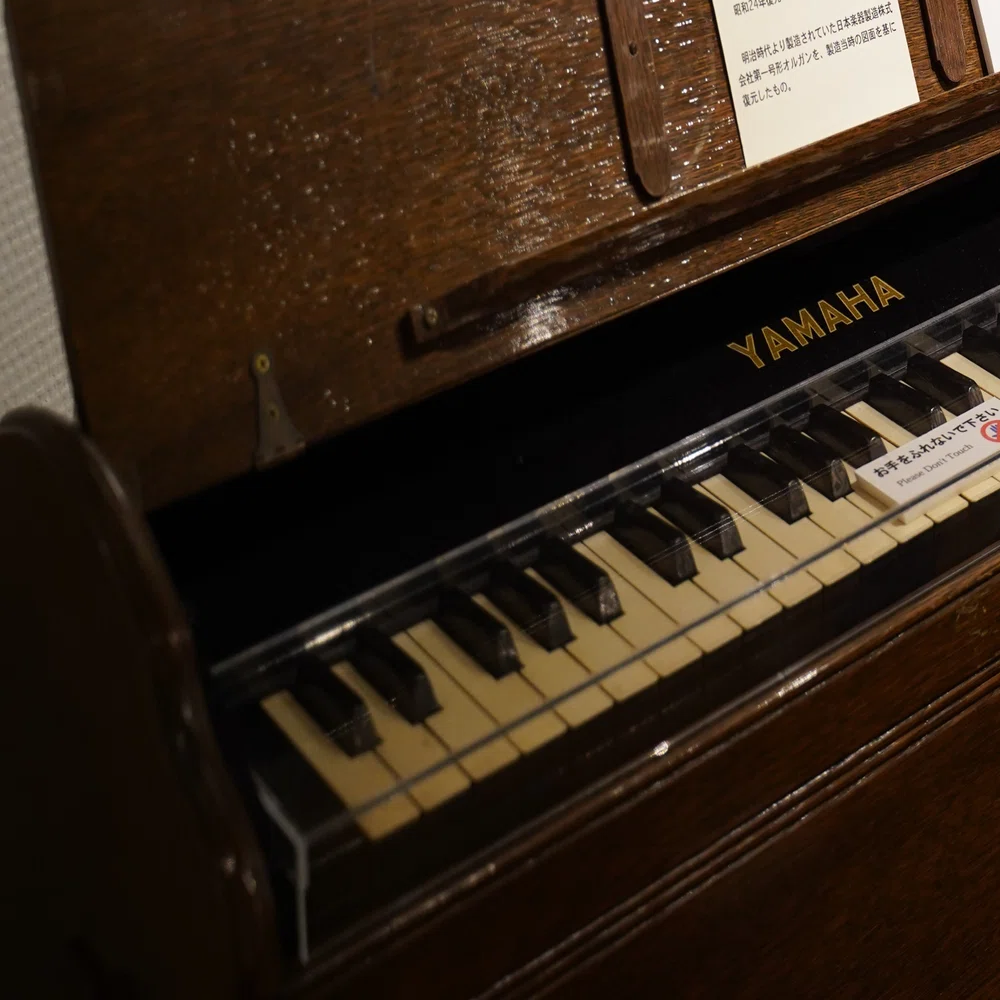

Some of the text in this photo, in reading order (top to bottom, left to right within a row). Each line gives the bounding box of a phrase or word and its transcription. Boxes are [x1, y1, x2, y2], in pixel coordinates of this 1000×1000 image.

[738, 21, 897, 88] 会社第一号形オルガンを、製造当時の図面を基に
[741, 1, 893, 64] 明治時代より製造されていた日本楽器製造株式
[742, 81, 792, 108] 復元したもの。
[727, 275, 905, 369] YAMAHA
[873, 407, 999, 478] お手をふれないで下さい
[896, 443, 974, 487] Please Don't Touch
